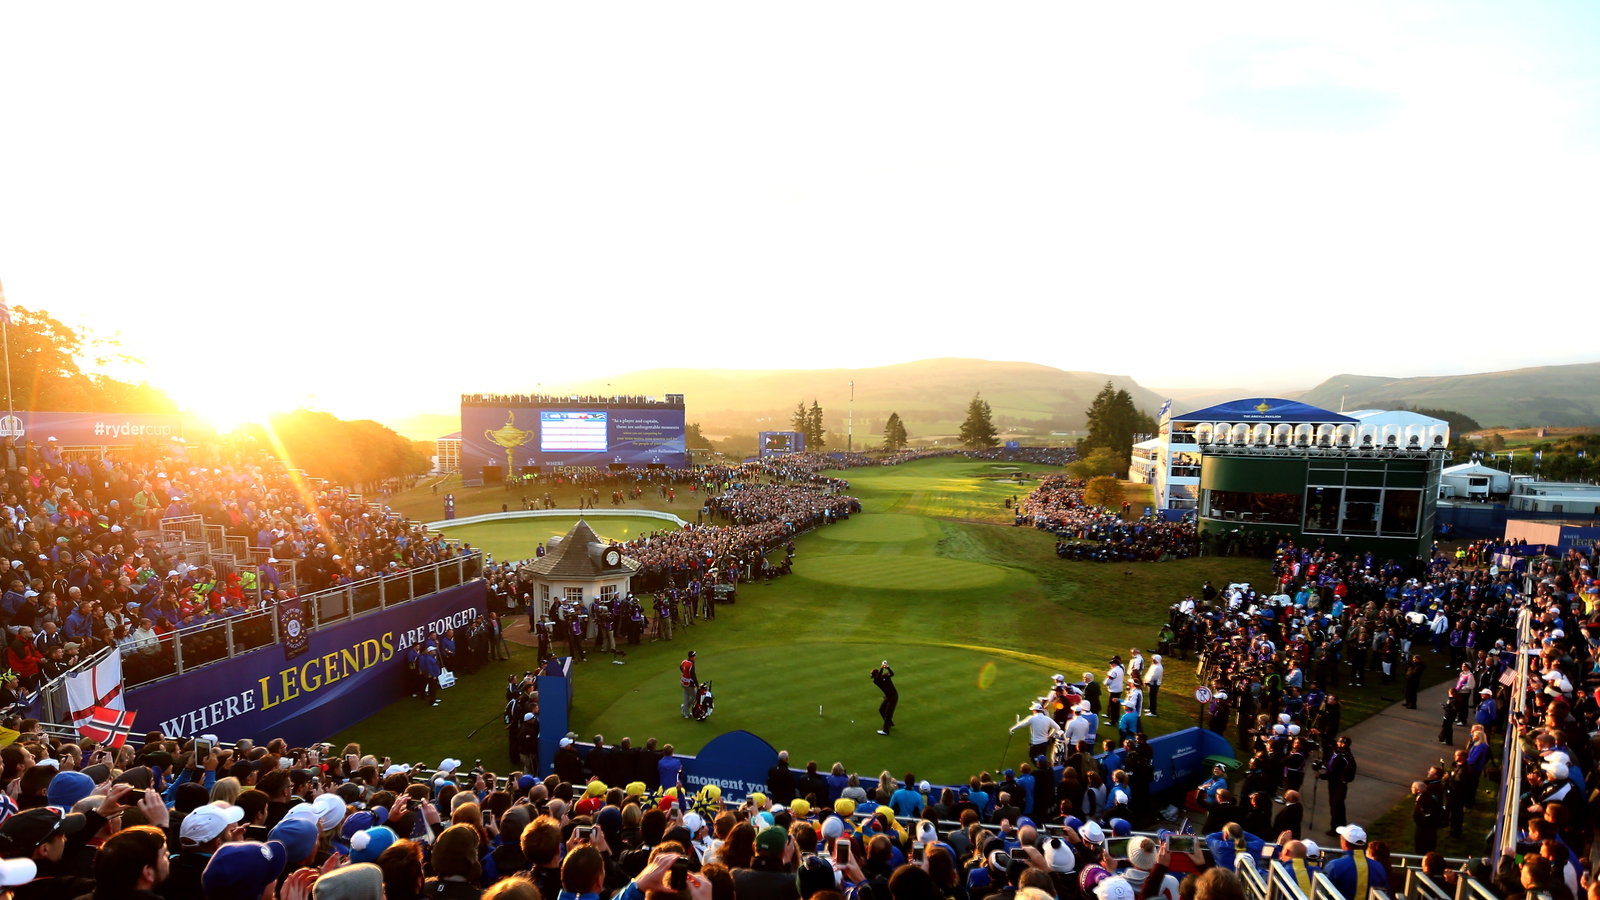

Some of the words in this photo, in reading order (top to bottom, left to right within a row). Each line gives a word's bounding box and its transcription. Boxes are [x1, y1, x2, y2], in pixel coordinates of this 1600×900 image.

[94, 421, 171, 438] #rydercup
[553, 465, 597, 474] LEGENDS
[159, 688, 256, 738] WHERE
[257, 631, 395, 711] LEGENDS
[397, 626, 425, 651] ARE
[428, 607, 477, 636] FORGED
[686, 774, 744, 791] moment
